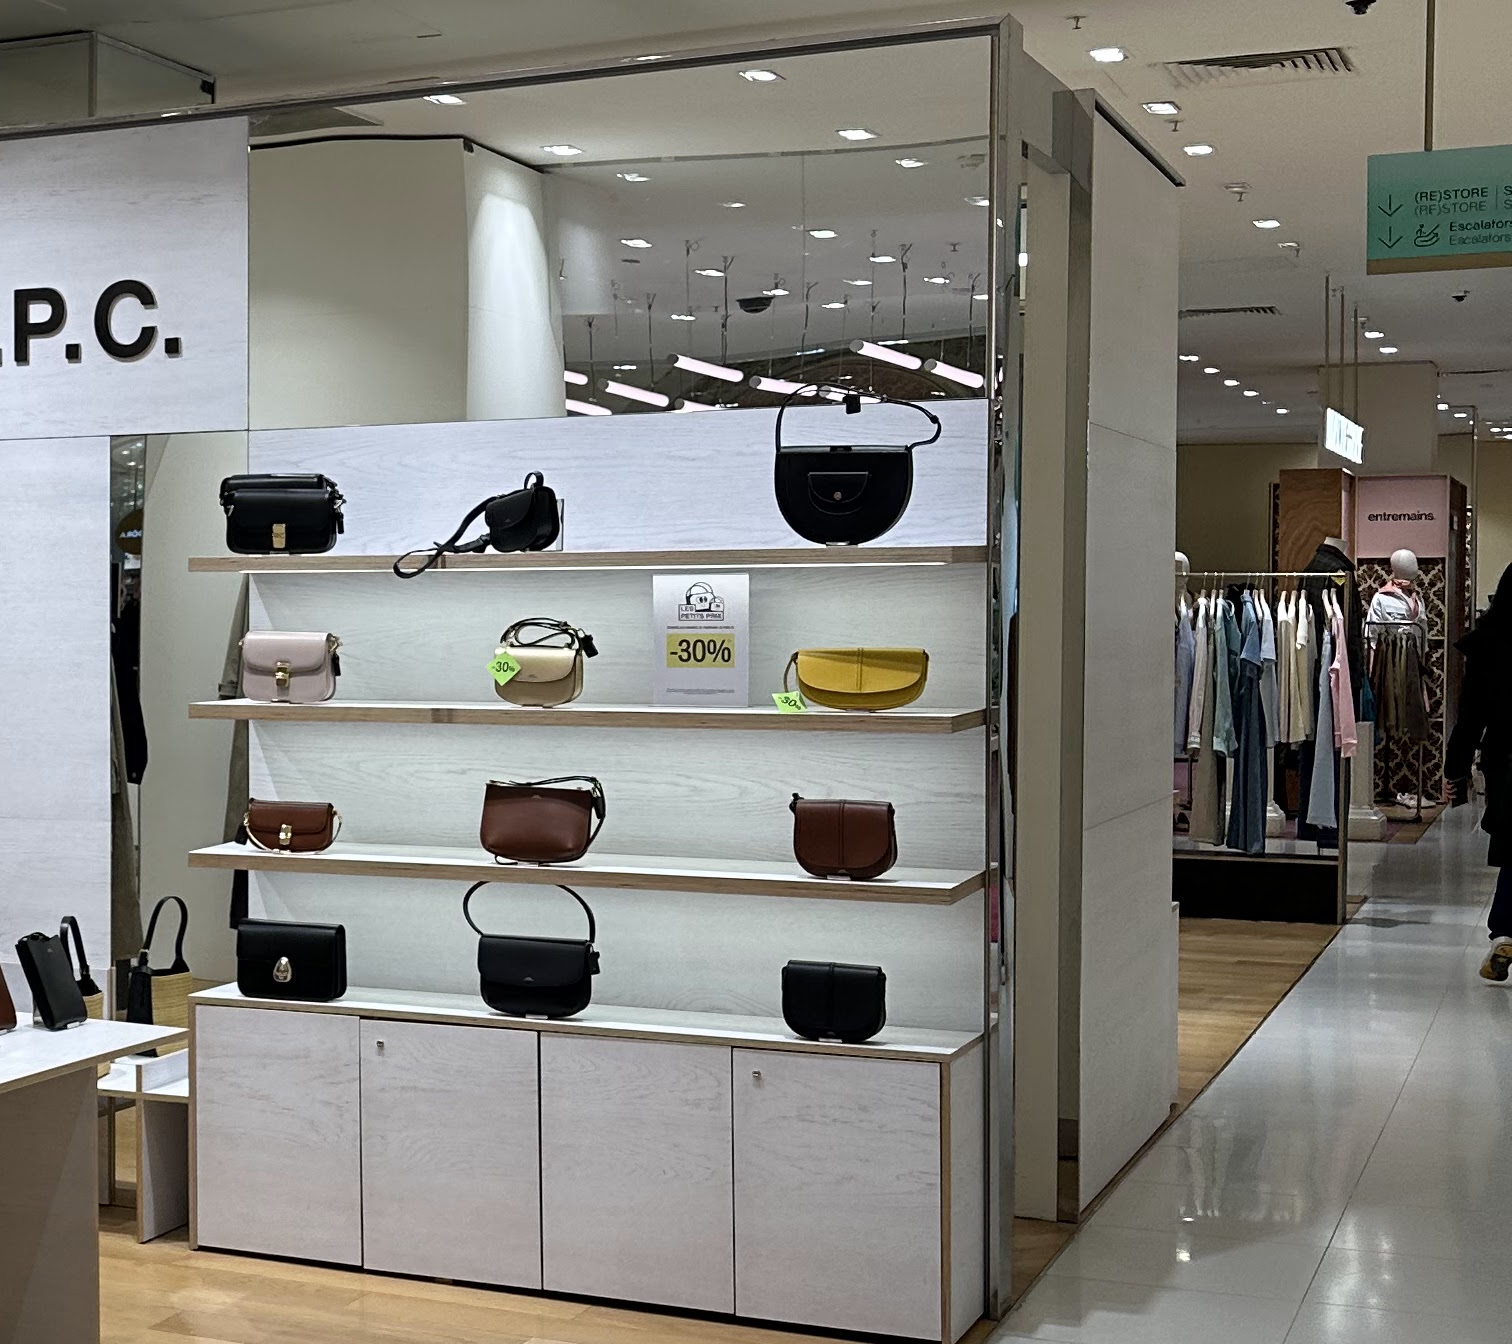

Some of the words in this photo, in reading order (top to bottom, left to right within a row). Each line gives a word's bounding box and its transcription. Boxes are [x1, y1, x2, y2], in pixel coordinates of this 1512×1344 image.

[1414, 187, 1489, 204] (RE)STORE
[1414, 200, 1487, 216] (RE)STORE
[1449, 233, 1512, 246] Escalators
